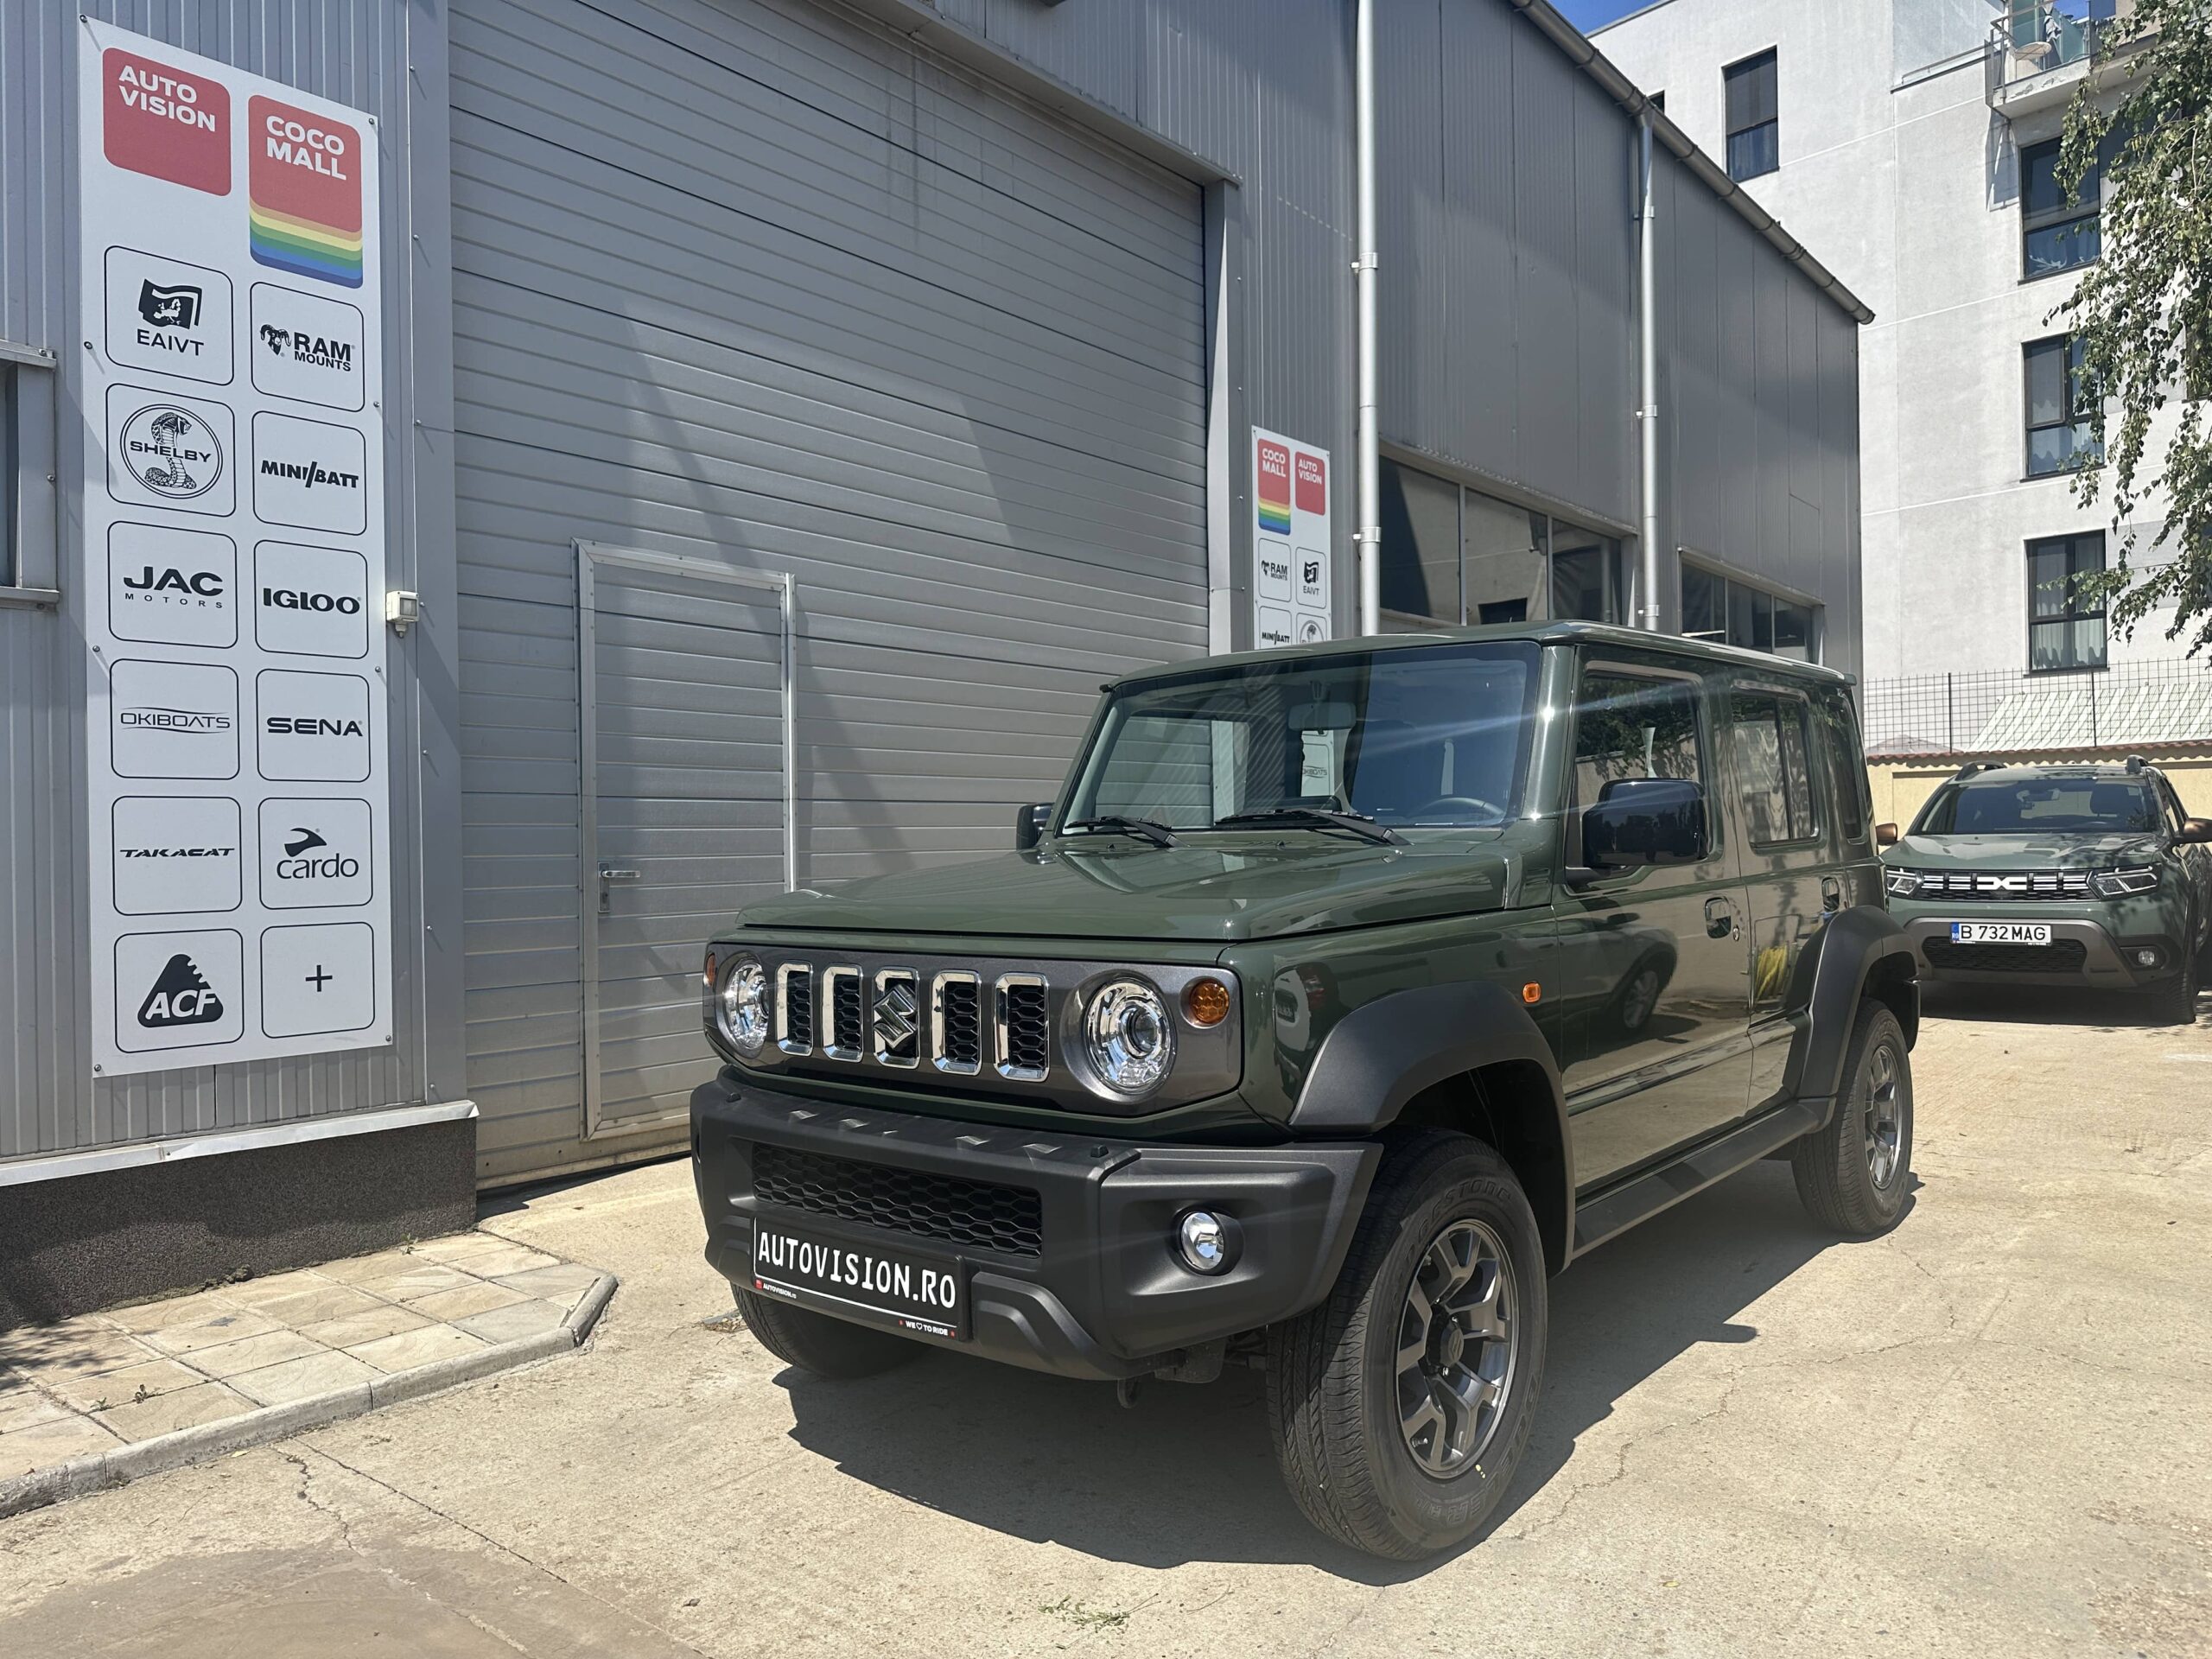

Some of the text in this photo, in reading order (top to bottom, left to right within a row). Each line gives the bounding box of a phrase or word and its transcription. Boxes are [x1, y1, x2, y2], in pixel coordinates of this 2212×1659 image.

[118, 65, 197, 104] AUTO
[118, 85, 216, 132] VISION
[266, 115, 345, 156] COCO
[266, 137, 346, 181] MALL
[137, 328, 204, 356] EAIVT
[294, 331, 351, 362] RAM
[295, 350, 351, 372] MOUNTS
[130, 440, 212, 463] SHELBY
[1262, 448, 1286, 465] COCO
[261, 461, 359, 488] MINI/BATT
[1262, 460, 1287, 478] MALL
[1299, 458, 1318, 473] AUTO
[1299, 468, 1323, 485] VISION
[1270, 562, 1287, 575] RAM
[123, 566, 224, 596] JAC
[1303, 585, 1319, 596] EAIVT
[124, 593, 223, 609] MOTORS
[263, 588, 360, 614] IGLOO
[120, 712, 231, 729] OKIBOATS
[266, 716, 363, 737] SENA
[276, 853, 359, 880] cardo
[1961, 925, 2046, 941] B 732 MAG
[144, 988, 217, 1020] ACF
[758, 1231, 956, 1309] AUTOVISION.RO
[905, 1319, 949, 1336] WE TO RIDE
